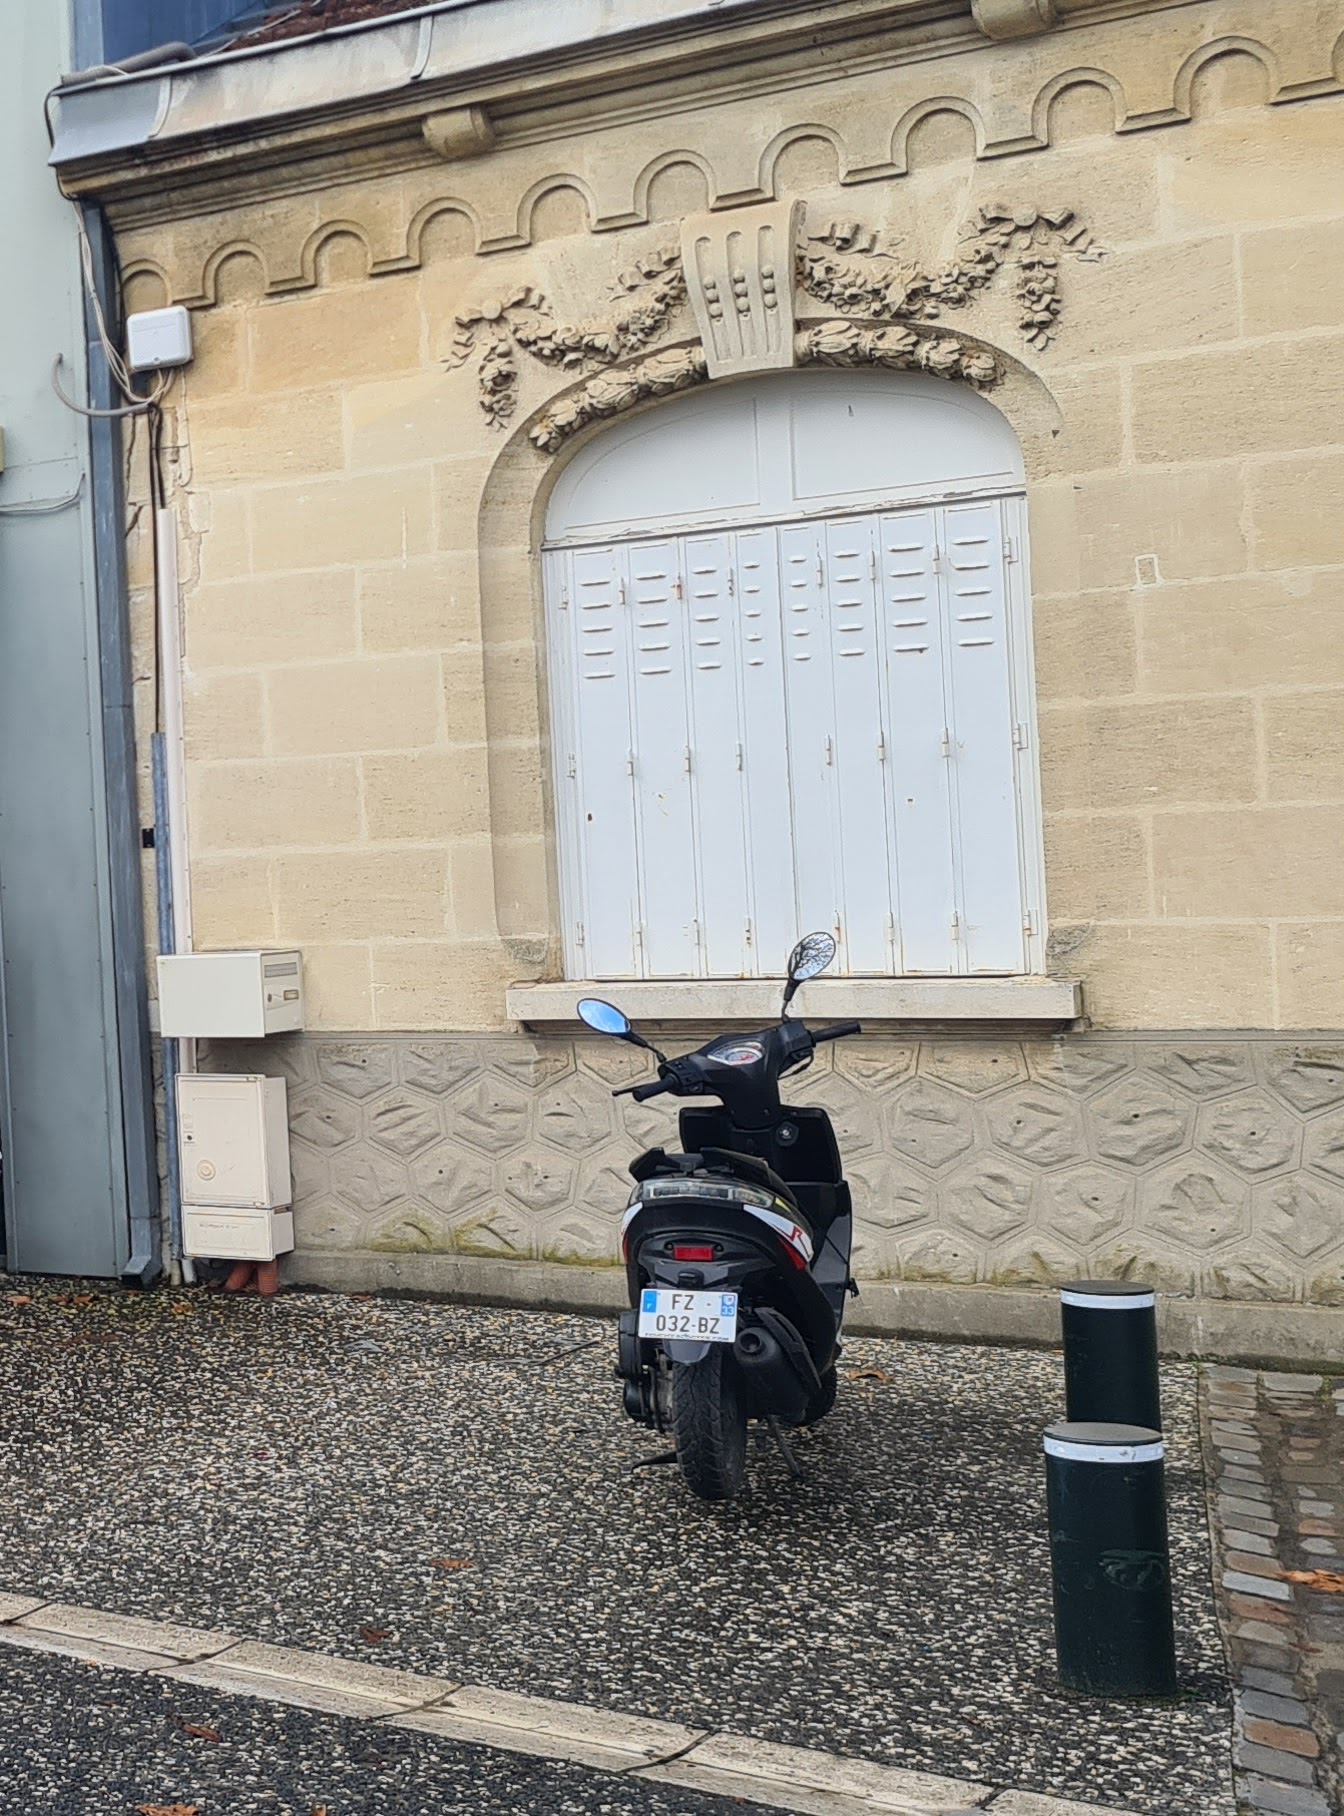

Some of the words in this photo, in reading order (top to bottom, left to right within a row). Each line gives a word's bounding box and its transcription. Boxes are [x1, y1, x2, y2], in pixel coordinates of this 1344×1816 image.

[672, 1293, 694, 1311] FZ
[722, 1306, 735, 1315] 33
[656, 1314, 720, 1335] 032-BZ
